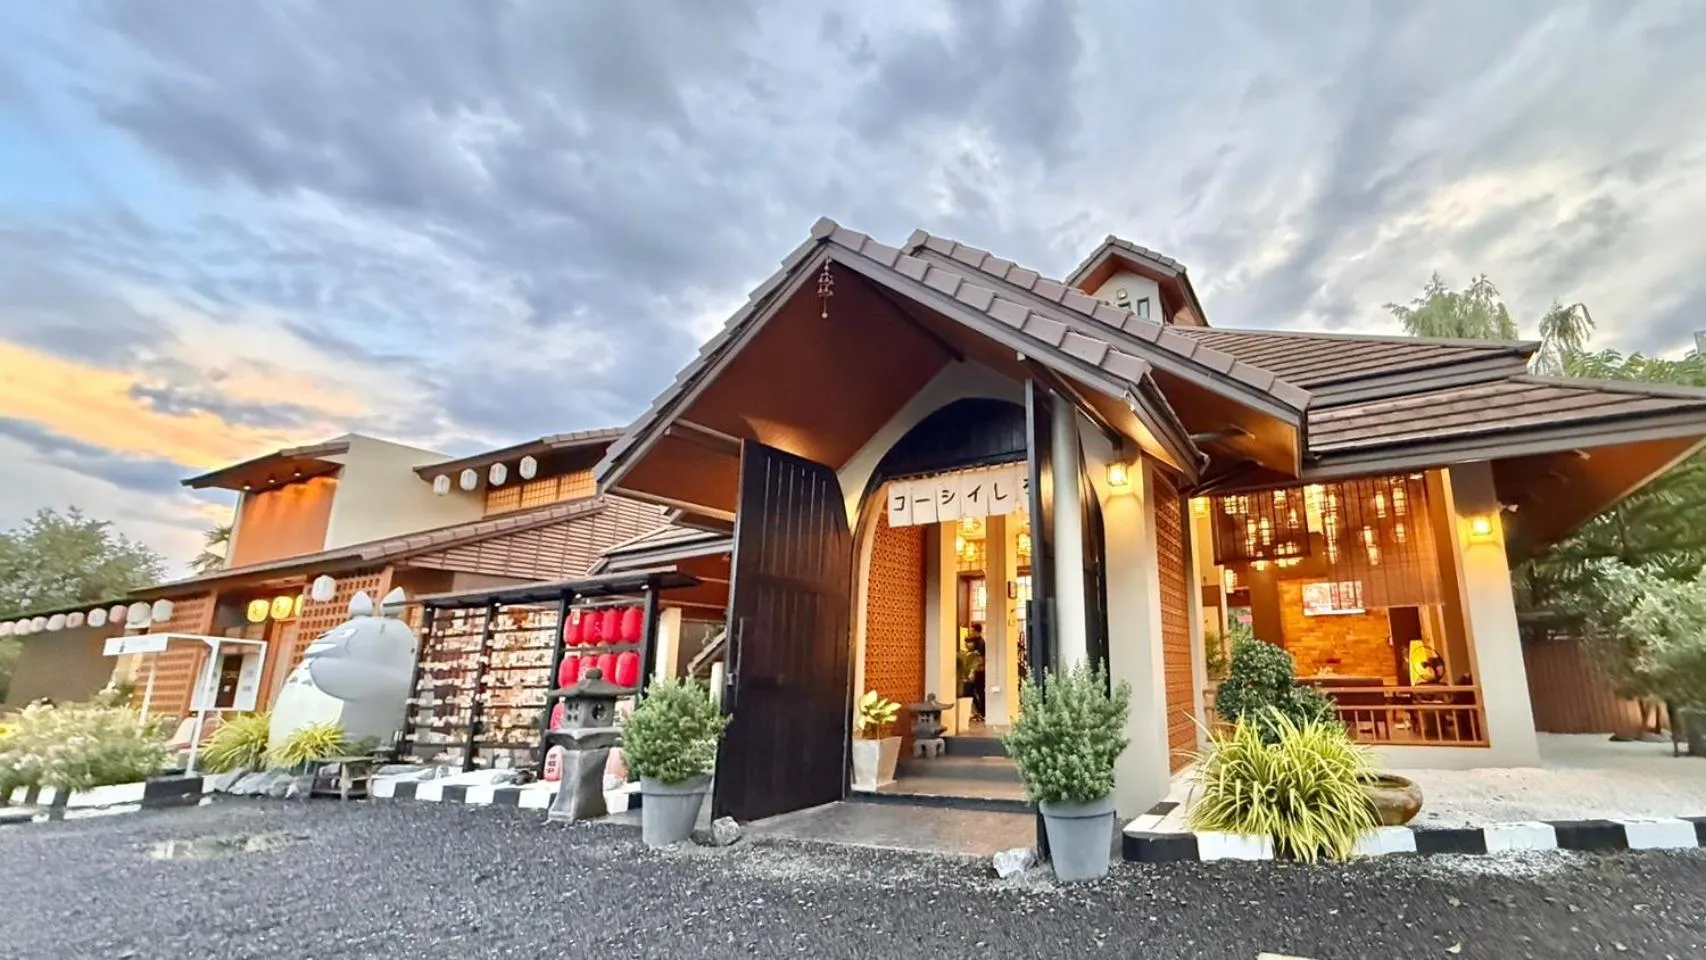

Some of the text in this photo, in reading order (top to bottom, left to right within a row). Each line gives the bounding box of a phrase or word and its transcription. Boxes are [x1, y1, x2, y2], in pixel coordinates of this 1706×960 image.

[893, 478, 1028, 512] コーシイし
